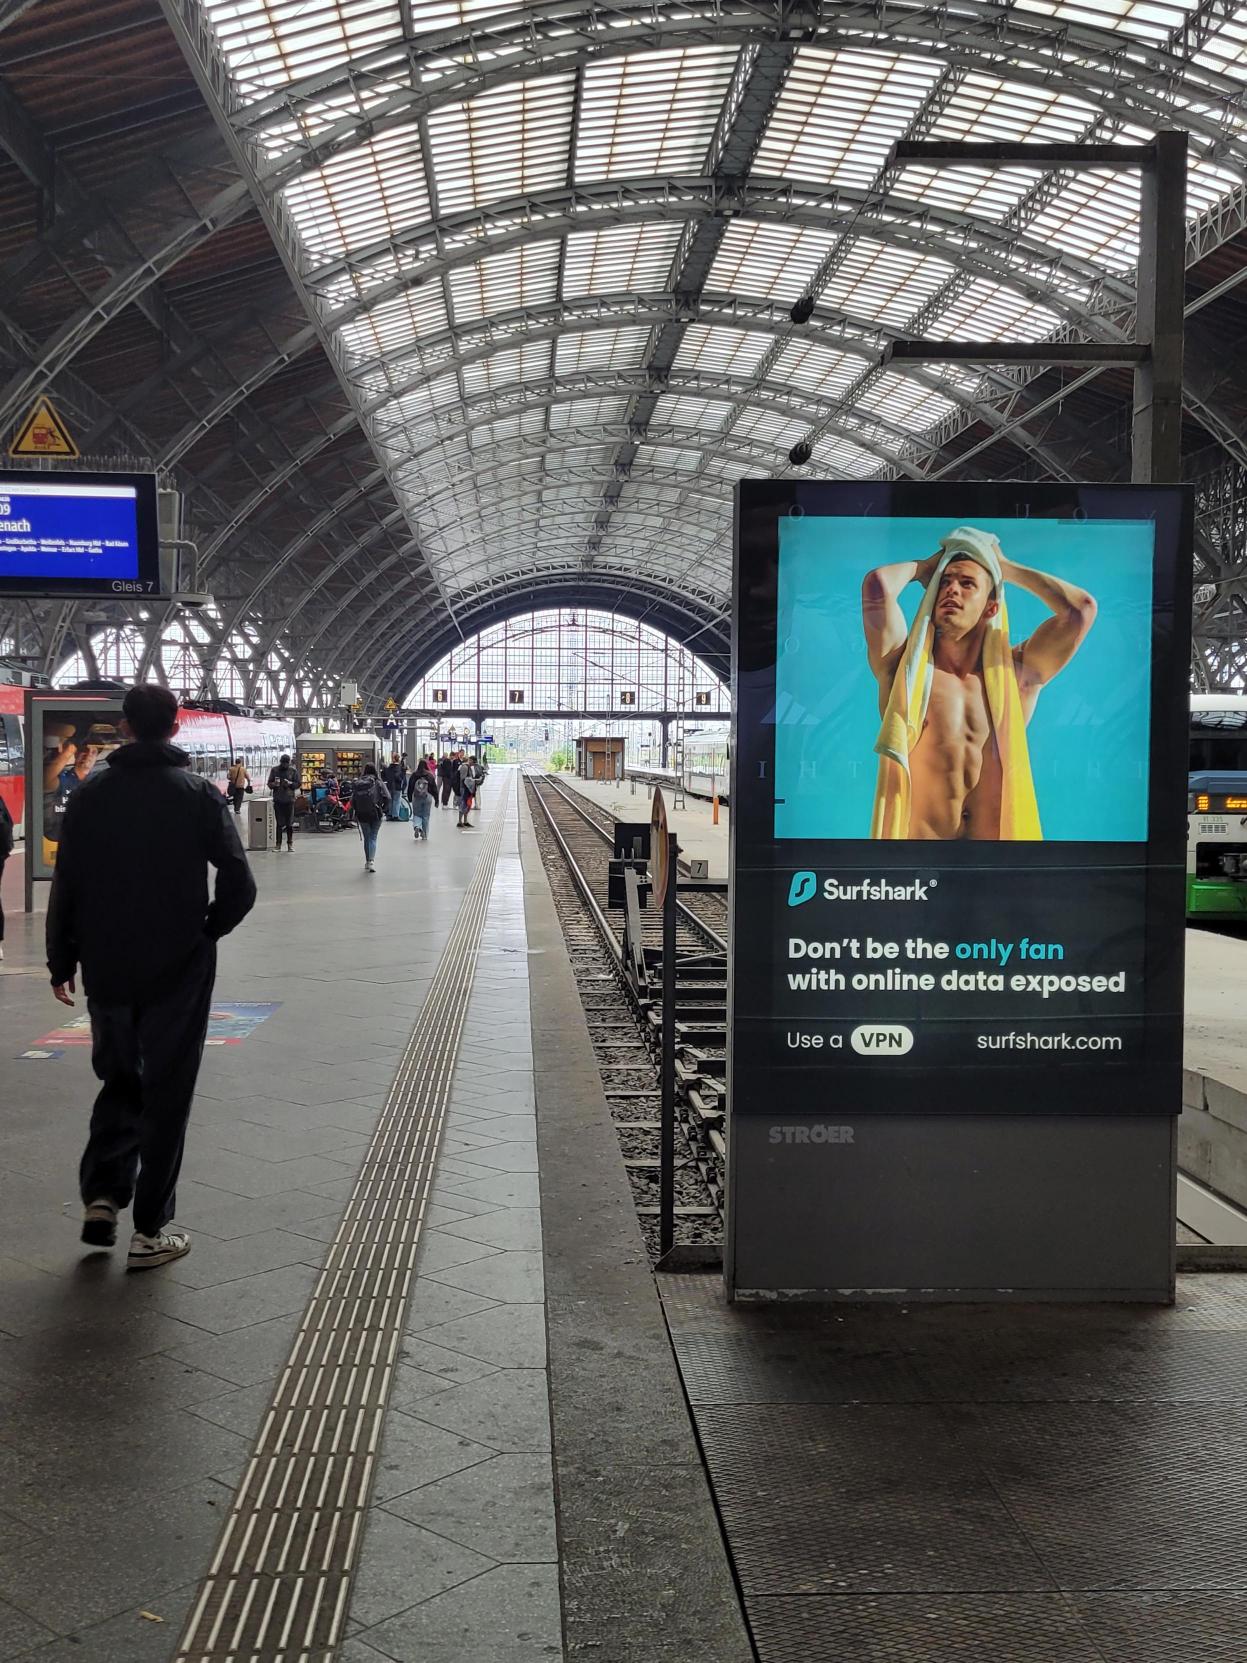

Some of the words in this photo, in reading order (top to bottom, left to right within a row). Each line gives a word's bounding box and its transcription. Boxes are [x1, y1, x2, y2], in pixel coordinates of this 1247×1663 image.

[112, 580, 143, 592] Gleis
[146, 581, 154, 592] 7
[514, 691, 519, 703] 7
[701, 693, 707, 705] 9
[697, 863, 703, 874] 7
[867, 938, 899, 959] be
[905, 938, 949, 959] the
[956, 939, 1013, 966] only
[1019, 938, 1064, 960] fan
[788, 968, 846, 990] with
[852, 968, 935, 990] online
[941, 971, 1005, 991] data
[1010, 971, 1126, 998] exposed
[787, 1031, 823, 1048] Use
[829, 1035, 843, 1049] a
[860, 1032, 903, 1048] VPN
[977, 1031, 1122, 1050] surfshark.com
[769, 1124, 855, 1144] STRÖER
